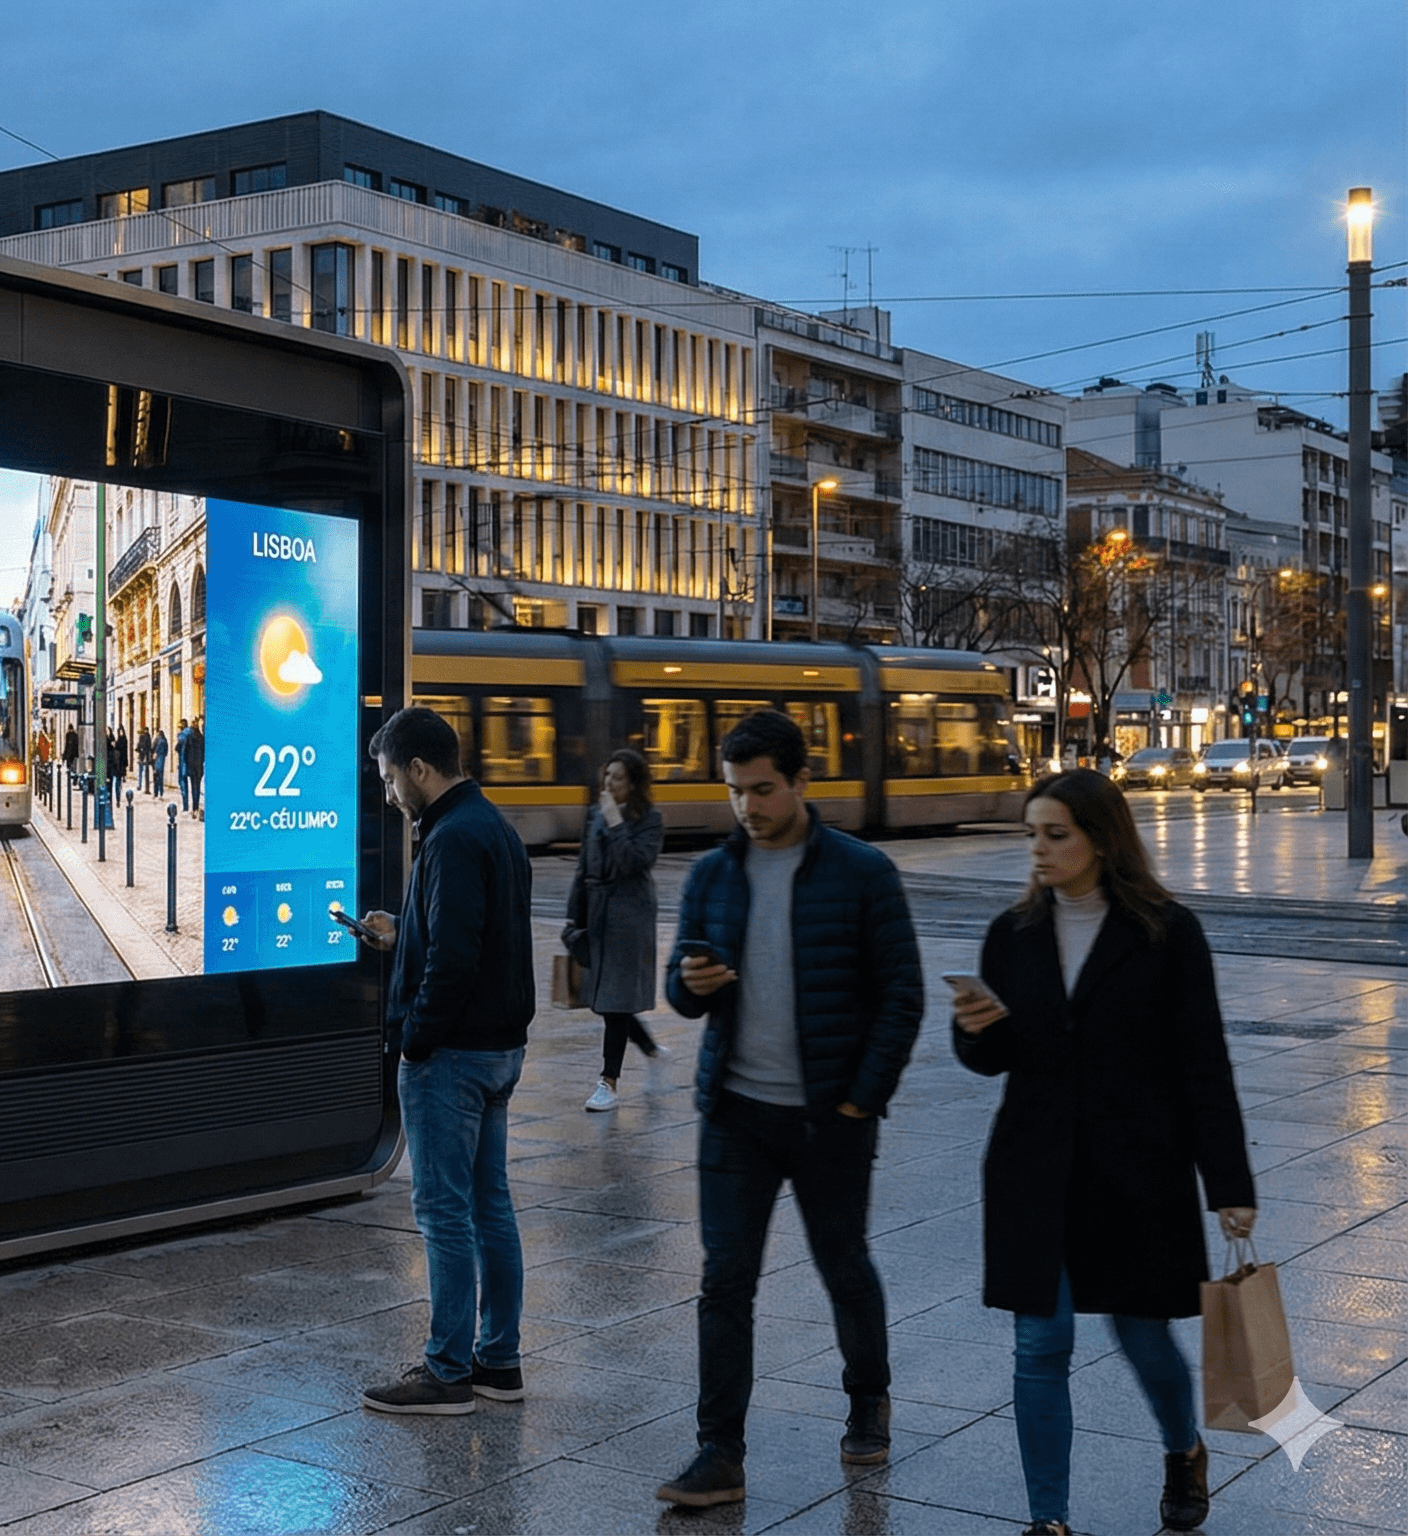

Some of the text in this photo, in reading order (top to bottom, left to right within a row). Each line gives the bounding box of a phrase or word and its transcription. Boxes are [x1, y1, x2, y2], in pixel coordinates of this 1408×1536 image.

[253, 531, 317, 563] LISBOA
[254, 744, 316, 797] 22°
[270, 807, 296, 830] CÉU
[298, 810, 338, 829] LIMPO
